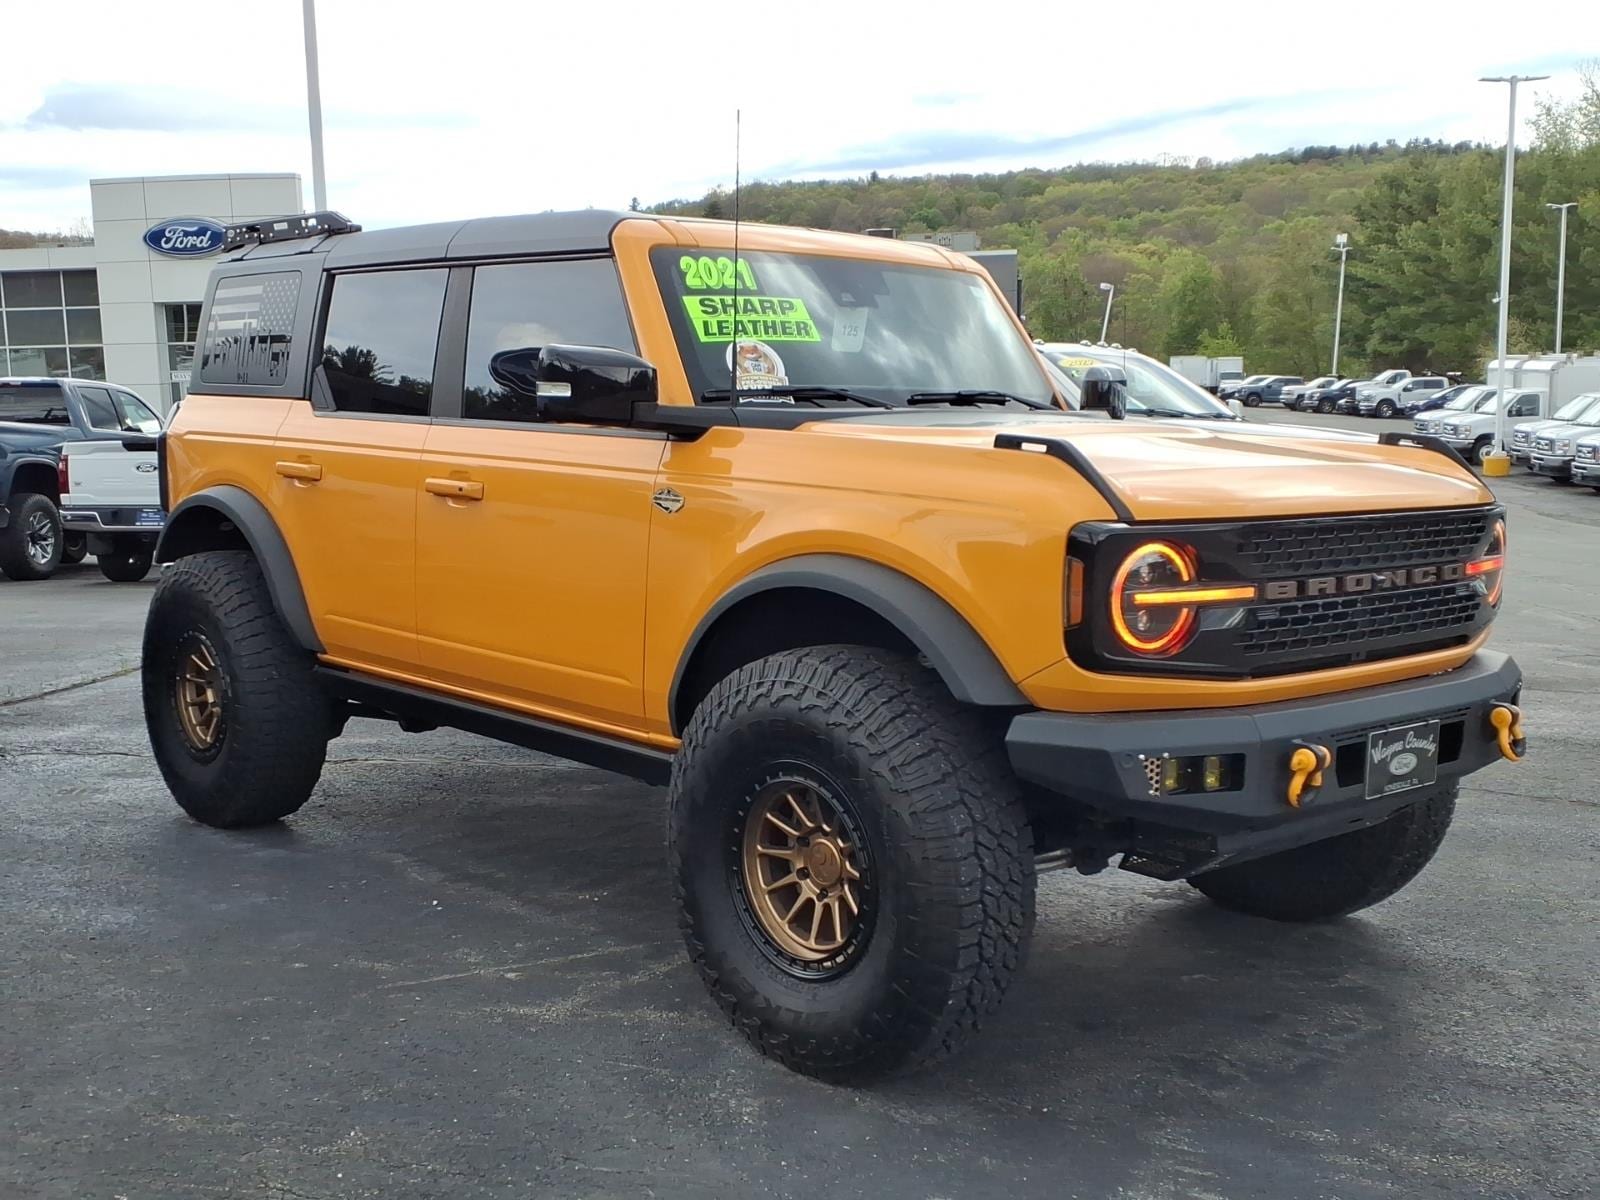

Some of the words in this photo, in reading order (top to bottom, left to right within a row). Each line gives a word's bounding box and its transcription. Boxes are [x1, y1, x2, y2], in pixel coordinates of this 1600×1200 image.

[161, 226, 212, 249] Ford
[680, 255, 758, 290] 2021
[699, 297, 797, 317] SHARP
[702, 319, 814, 338] LEATHER
[1266, 563, 1464, 600] BRONCO
[1371, 739, 1404, 764] Wayne
[1405, 731, 1437, 757] County
